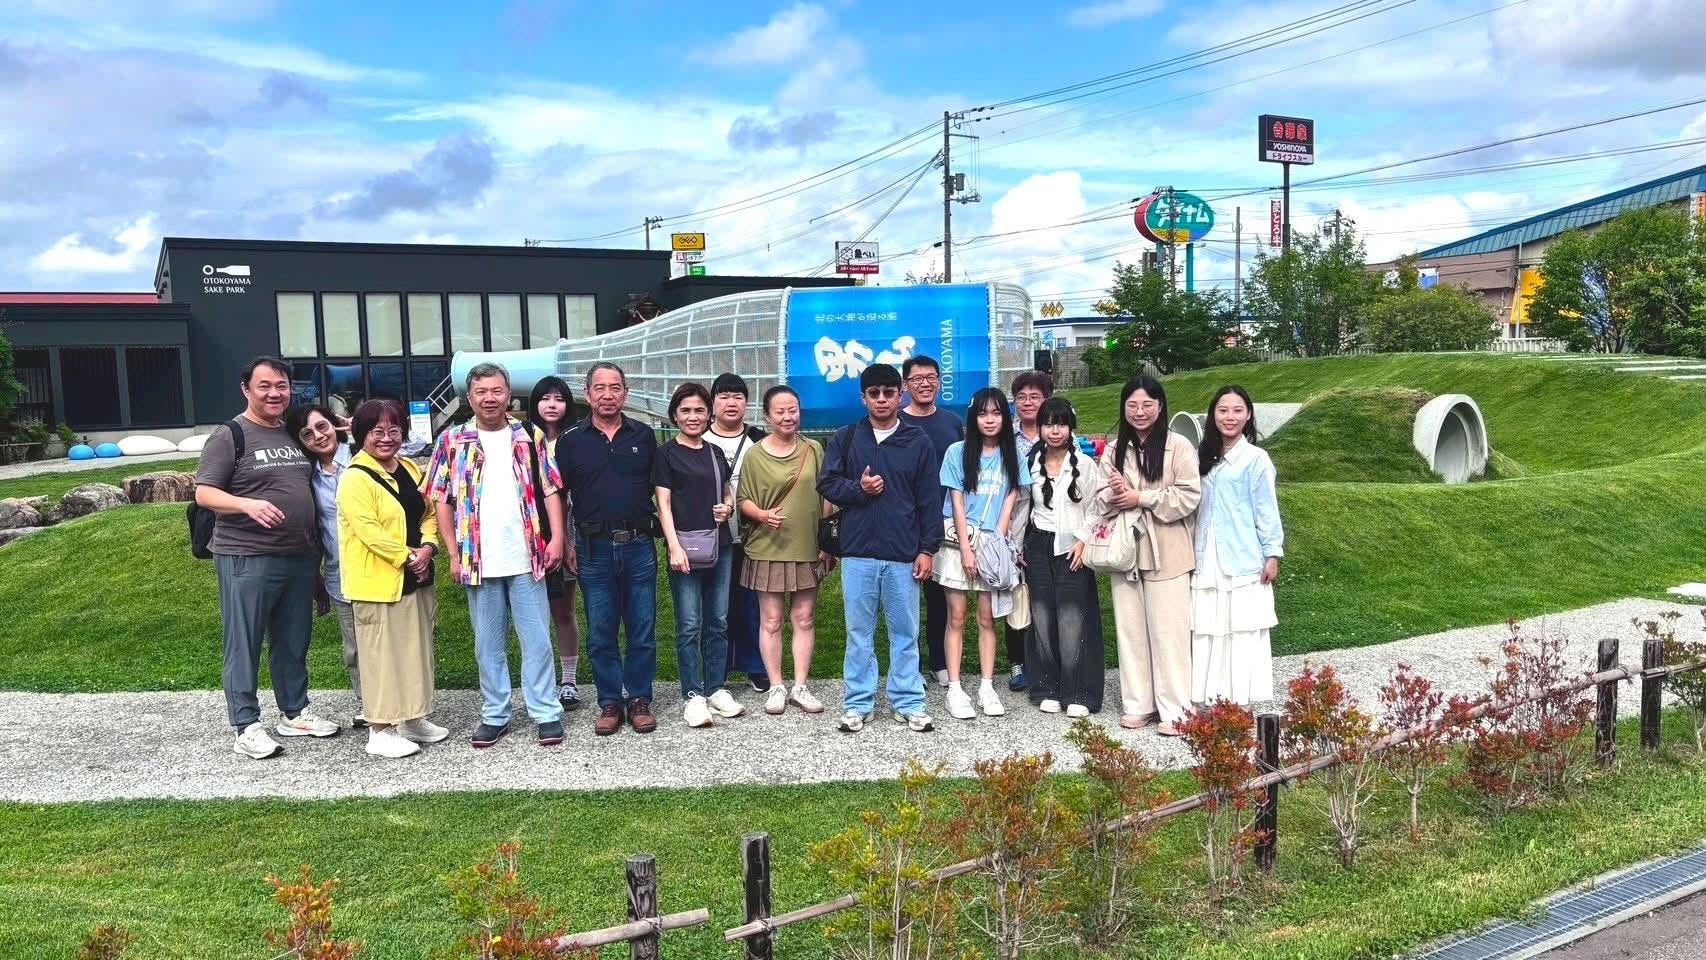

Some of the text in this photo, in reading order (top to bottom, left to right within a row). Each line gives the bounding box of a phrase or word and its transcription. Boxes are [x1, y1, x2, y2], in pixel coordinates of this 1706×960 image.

[1273, 121, 1307, 141] 吉野家
[1273, 143, 1307, 153] YOSHINOYA
[1272, 153, 1308, 161] ドライブスルー
[203, 277, 251, 285] OTOKOYAMA
[941, 319, 953, 402] OTOKOYAMA
